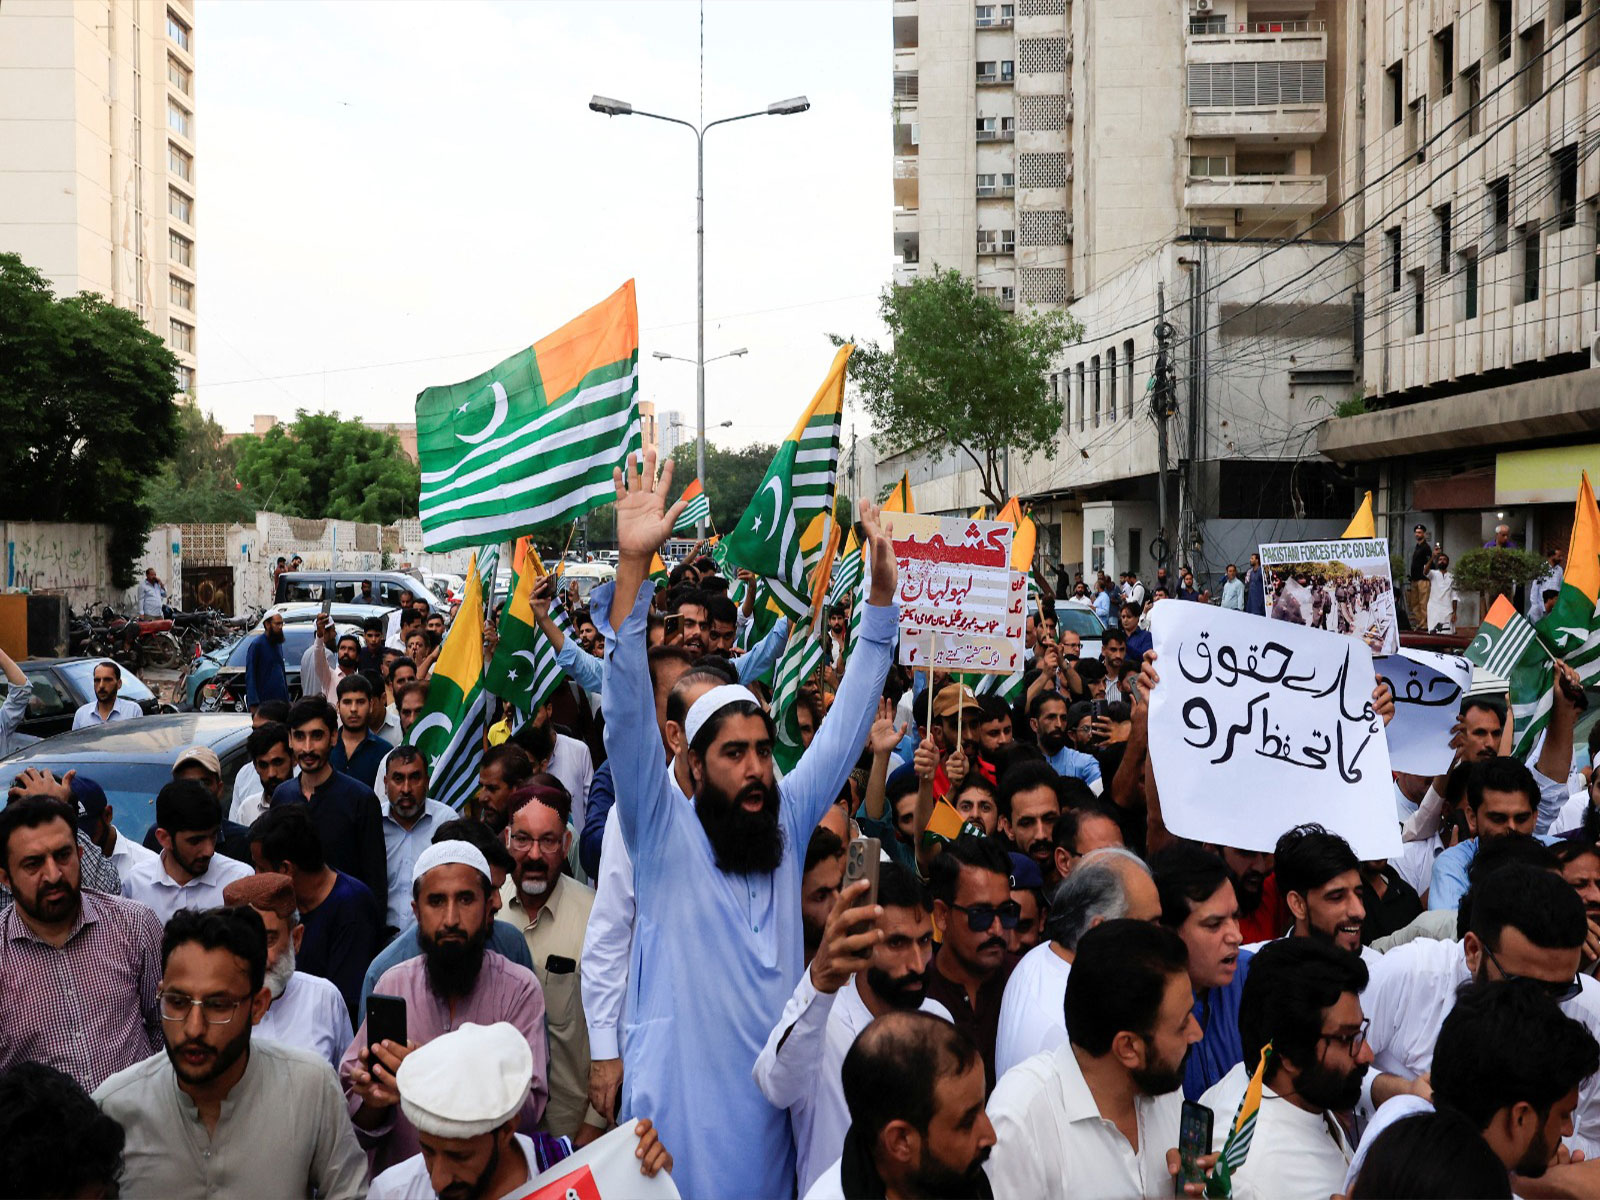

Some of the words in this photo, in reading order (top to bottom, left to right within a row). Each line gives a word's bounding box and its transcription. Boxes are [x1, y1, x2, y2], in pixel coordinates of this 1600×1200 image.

[892, 522, 1010, 570] کشمی
[1262, 546, 1300, 563] PAKISTANI
[1300, 544, 1331, 561] FORCES
[1353, 542, 1365, 558] GO
[1365, 541, 1387, 557] BACK
[1008, 598, 1022, 614] رنگ
[1011, 576, 1026, 591] خون
[980, 650, 1000, 666] لوگ
[1178, 632, 1293, 687] حقوق
[1281, 643, 1379, 734] ہمارے
[1182, 692, 1270, 765] کرو
[1255, 707, 1332, 769] تحفظ
[1337, 719, 1372, 783] کا
